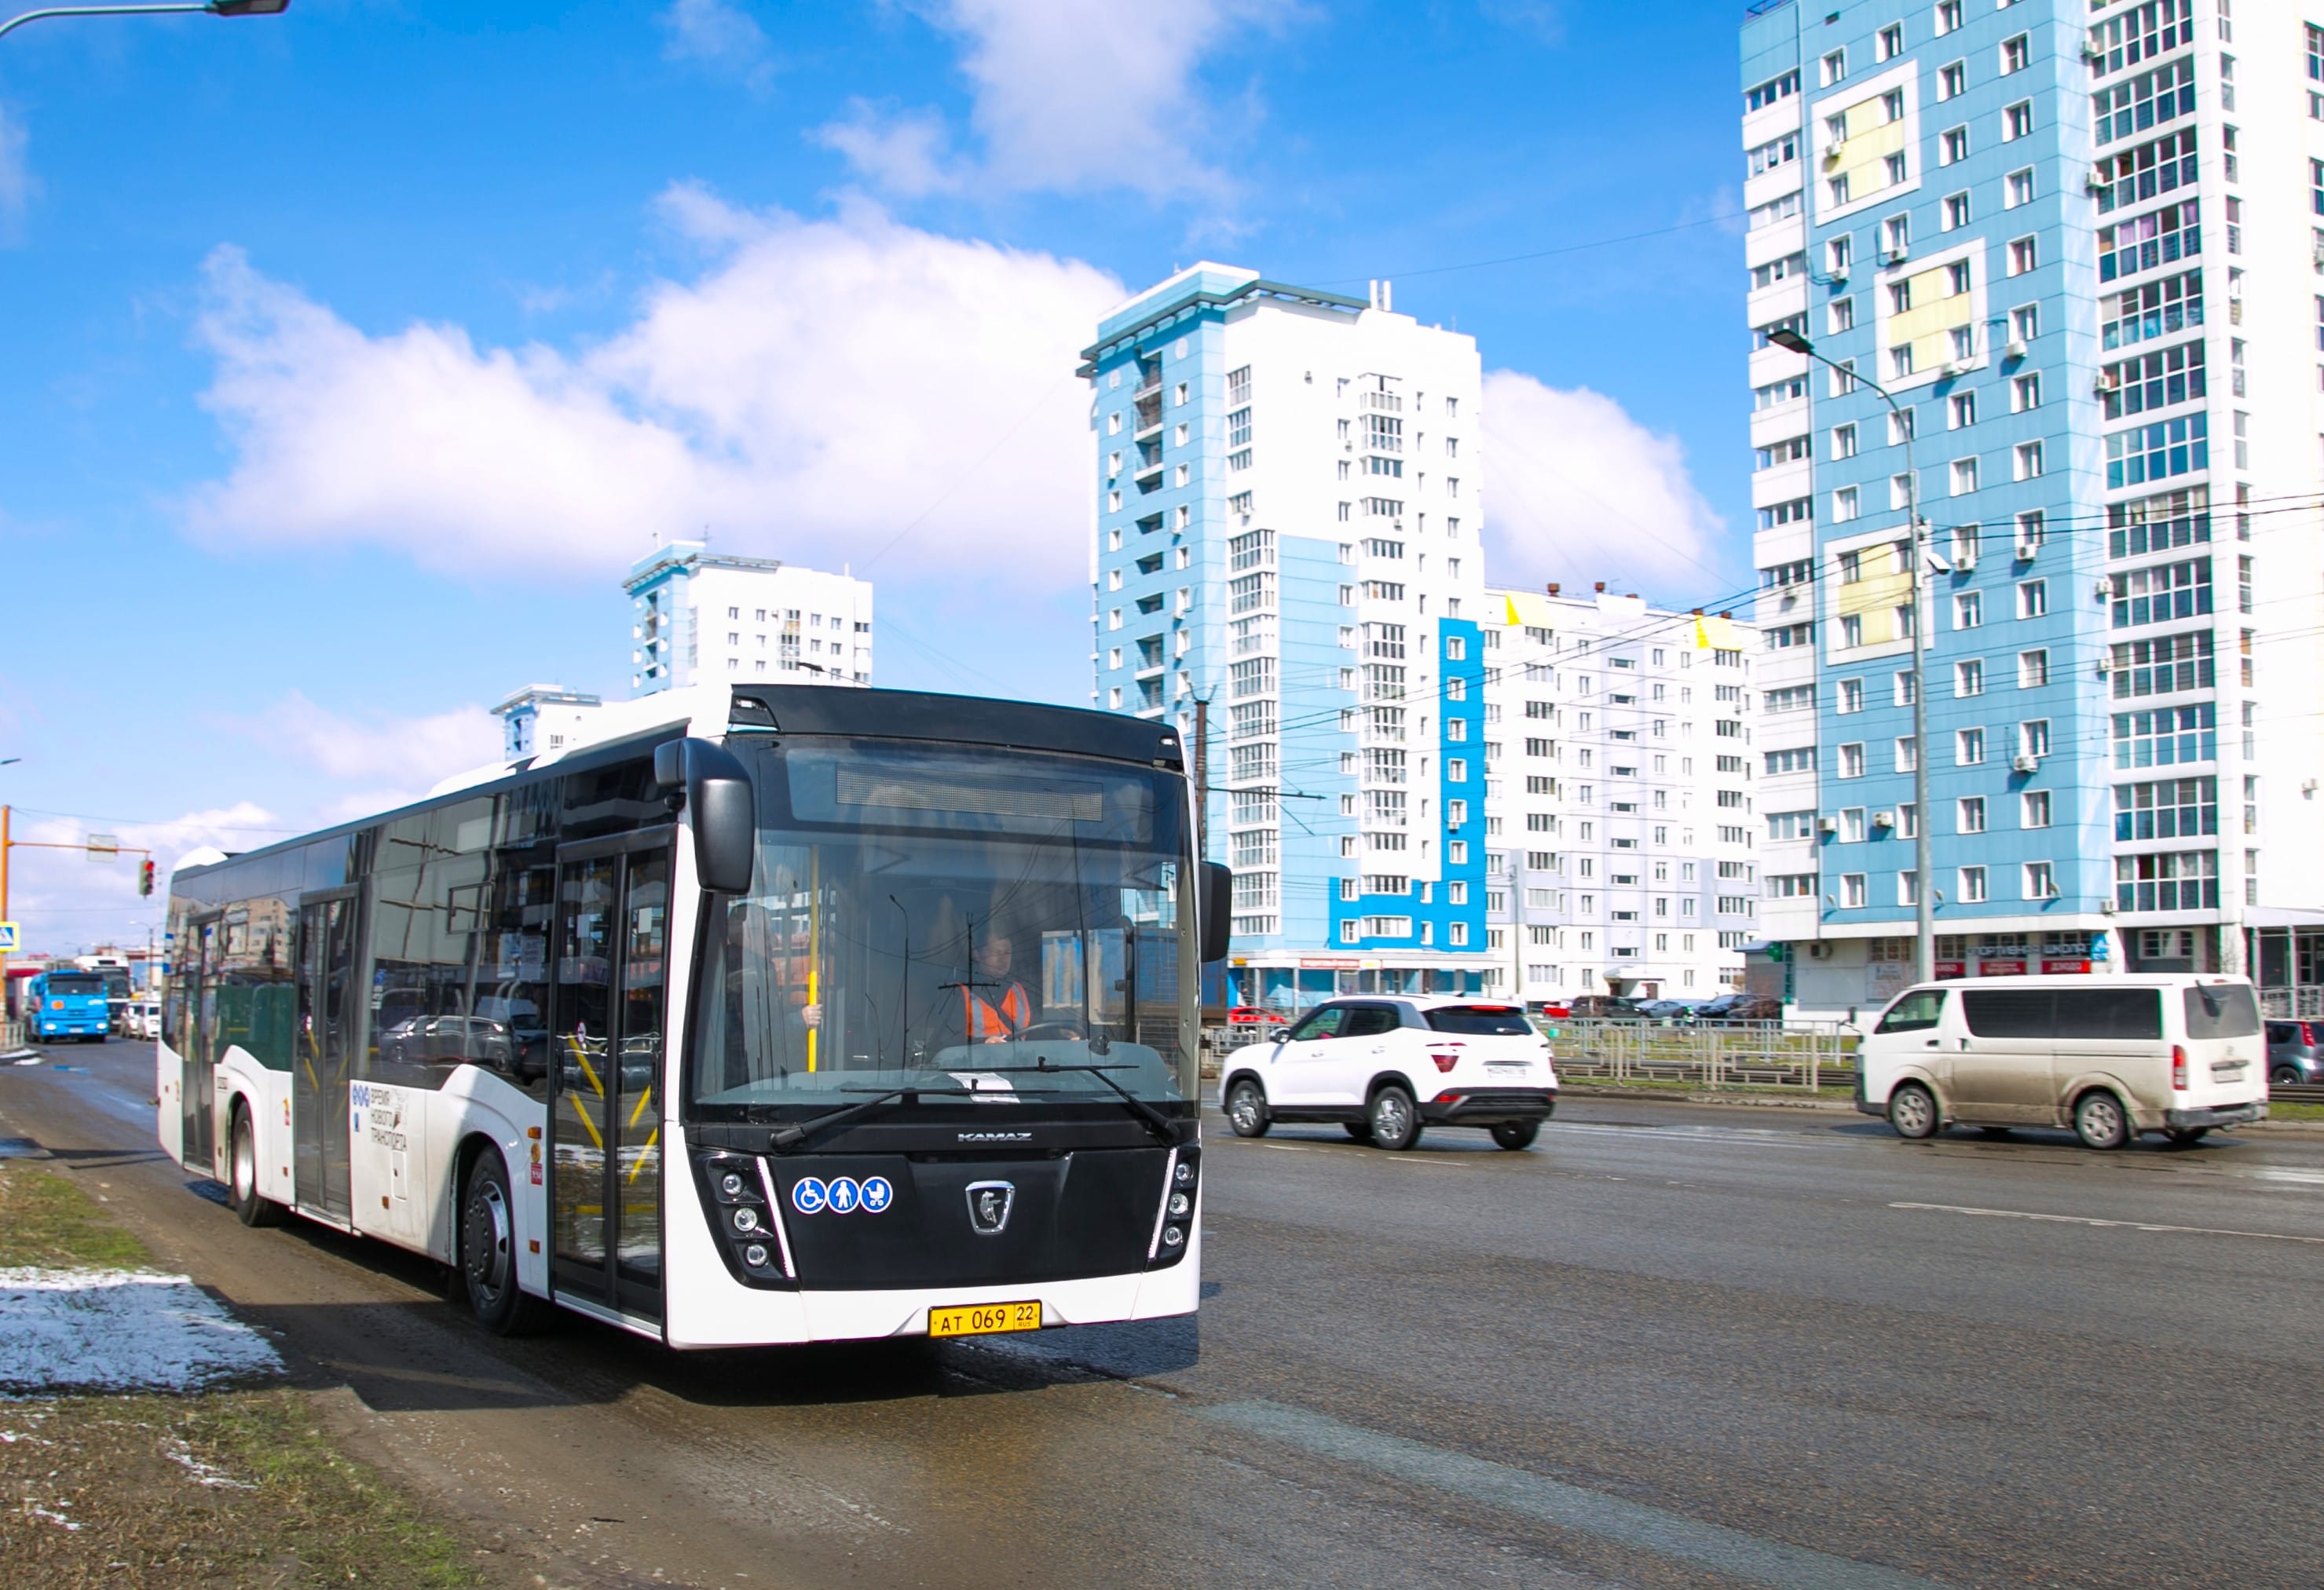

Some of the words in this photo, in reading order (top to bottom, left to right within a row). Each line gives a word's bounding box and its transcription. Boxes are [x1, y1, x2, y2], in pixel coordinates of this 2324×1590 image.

[371, 1088, 390, 1106] ВРЕМЯ
[371, 1108, 393, 1127] НОВОГО
[371, 1127, 408, 1151] ТРАНСПОРТА
[957, 1132, 1033, 1142] KAMAZ
[941, 1316, 962, 1332] АТ
[972, 1310, 1006, 1329] 069
[1016, 1306, 1034, 1321] 22
